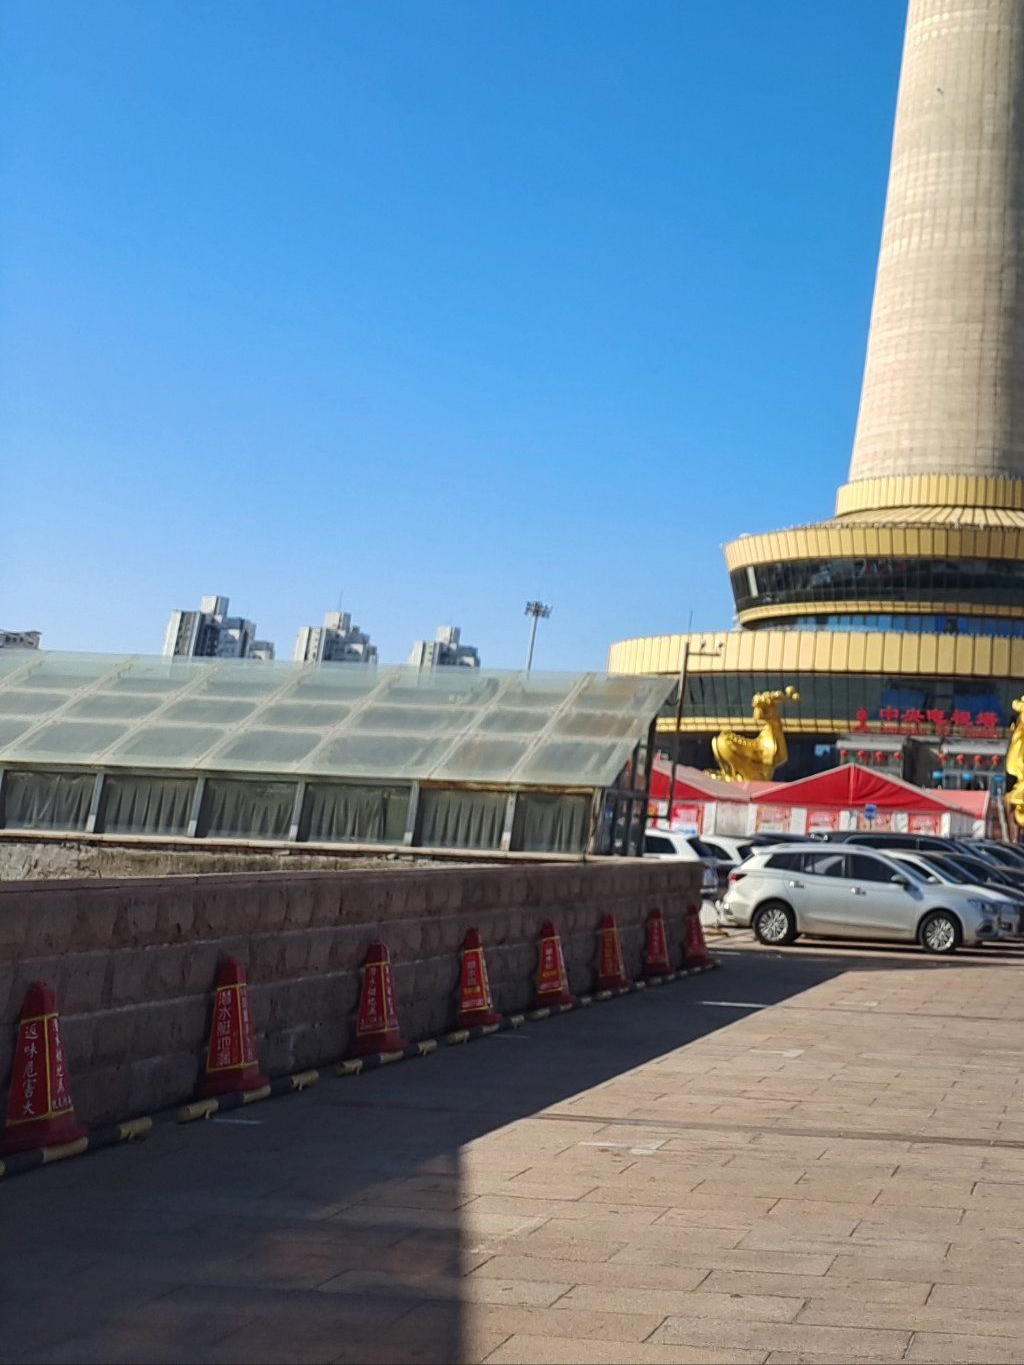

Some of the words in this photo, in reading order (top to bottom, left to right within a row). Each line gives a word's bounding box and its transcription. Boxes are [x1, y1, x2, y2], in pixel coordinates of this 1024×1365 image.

[880, 706, 999, 727] 中央电视塔
